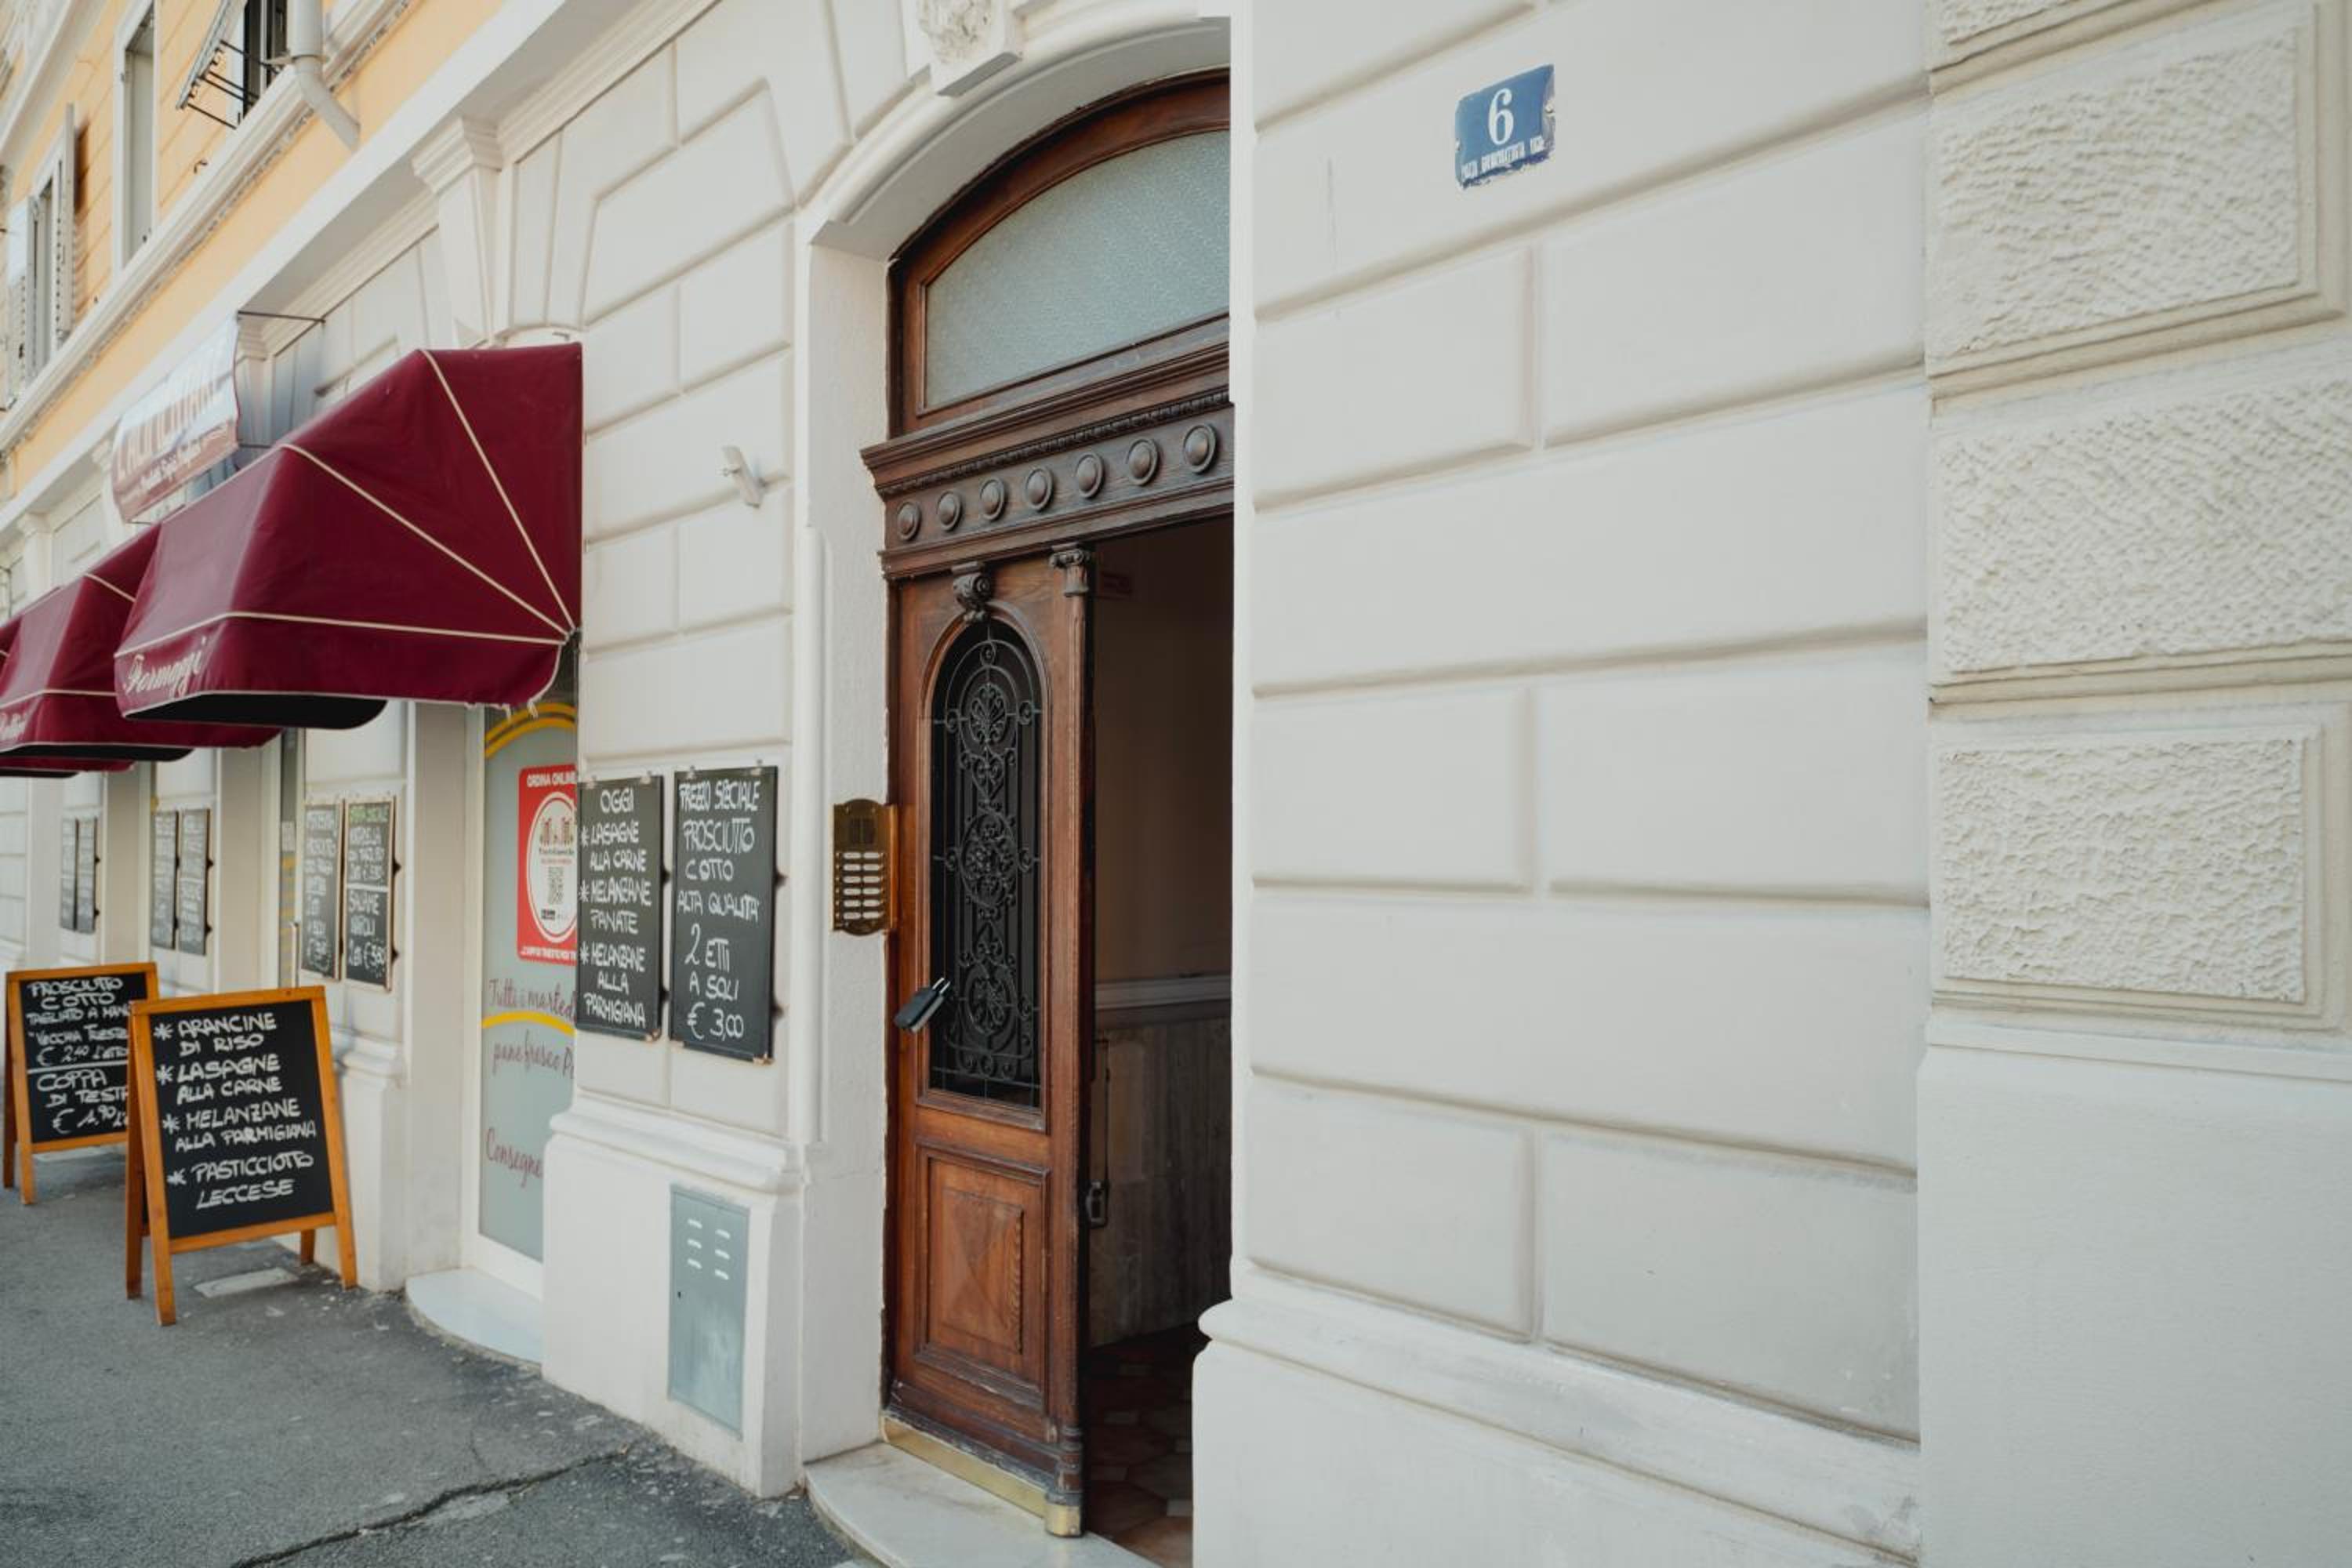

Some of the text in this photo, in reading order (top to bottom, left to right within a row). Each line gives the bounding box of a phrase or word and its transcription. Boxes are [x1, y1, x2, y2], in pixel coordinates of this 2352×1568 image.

[1488, 88, 1514, 145] 6
[601, 789, 634, 814] OGGI
[590, 820, 640, 846] LASAGNE
[683, 818, 755, 854] PROSCIUTTO
[590, 850, 610, 869] ALLA
[612, 850, 648, 873] CARNE
[684, 859, 735, 882] COTTO
[677, 890, 704, 917] ALTA
[590, 909, 639, 935] PANATE
[684, 923, 731, 971] 2 ETTI
[27, 977, 123, 997] PROSCIUTTO
[597, 972, 630, 995] ALLA
[689, 971, 740, 1002] A SOLI
[41, 992, 115, 1011] COTTO
[88, 1007, 99, 1019] A
[102, 1004, 129, 1018] MAN
[527, 982, 577, 1022] marted
[583, 992, 647, 1029] PARMIGIANA
[177, 1013, 277, 1040] ARANCINE
[687, 1002, 706, 1040] €
[180, 1033, 264, 1057] DI RISO
[37, 1069, 107, 1091] COPPA
[176, 1053, 281, 1083] LASAGNE
[45, 1093, 67, 1108] DI
[176, 1076, 282, 1105] ALLA CARNE
[52, 1108, 75, 1134] €
[186, 1098, 301, 1131] MELANZANE
[175, 1120, 317, 1152] ALLA PARMIGIANA
[191, 1150, 314, 1182] PASTICCIOTTO
[196, 1179, 296, 1209] LECCESE
